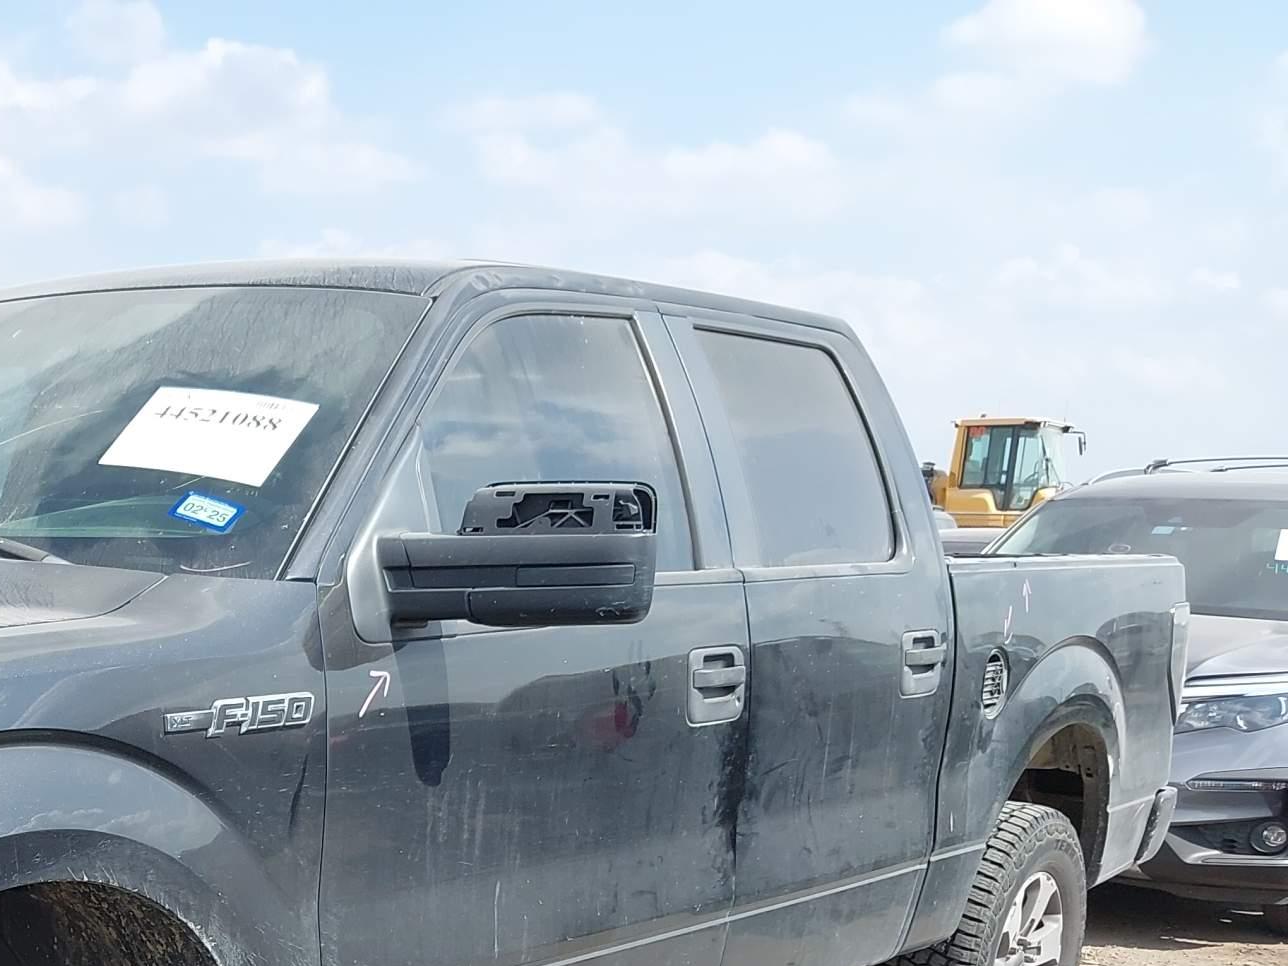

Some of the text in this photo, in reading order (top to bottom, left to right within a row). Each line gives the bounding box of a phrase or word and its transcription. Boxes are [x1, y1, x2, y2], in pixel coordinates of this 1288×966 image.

[155, 405, 283, 432] 44521088
[183, 502, 204, 516] 02
[207, 509, 229, 523] 25
[207, 692, 315, 738] F-150
